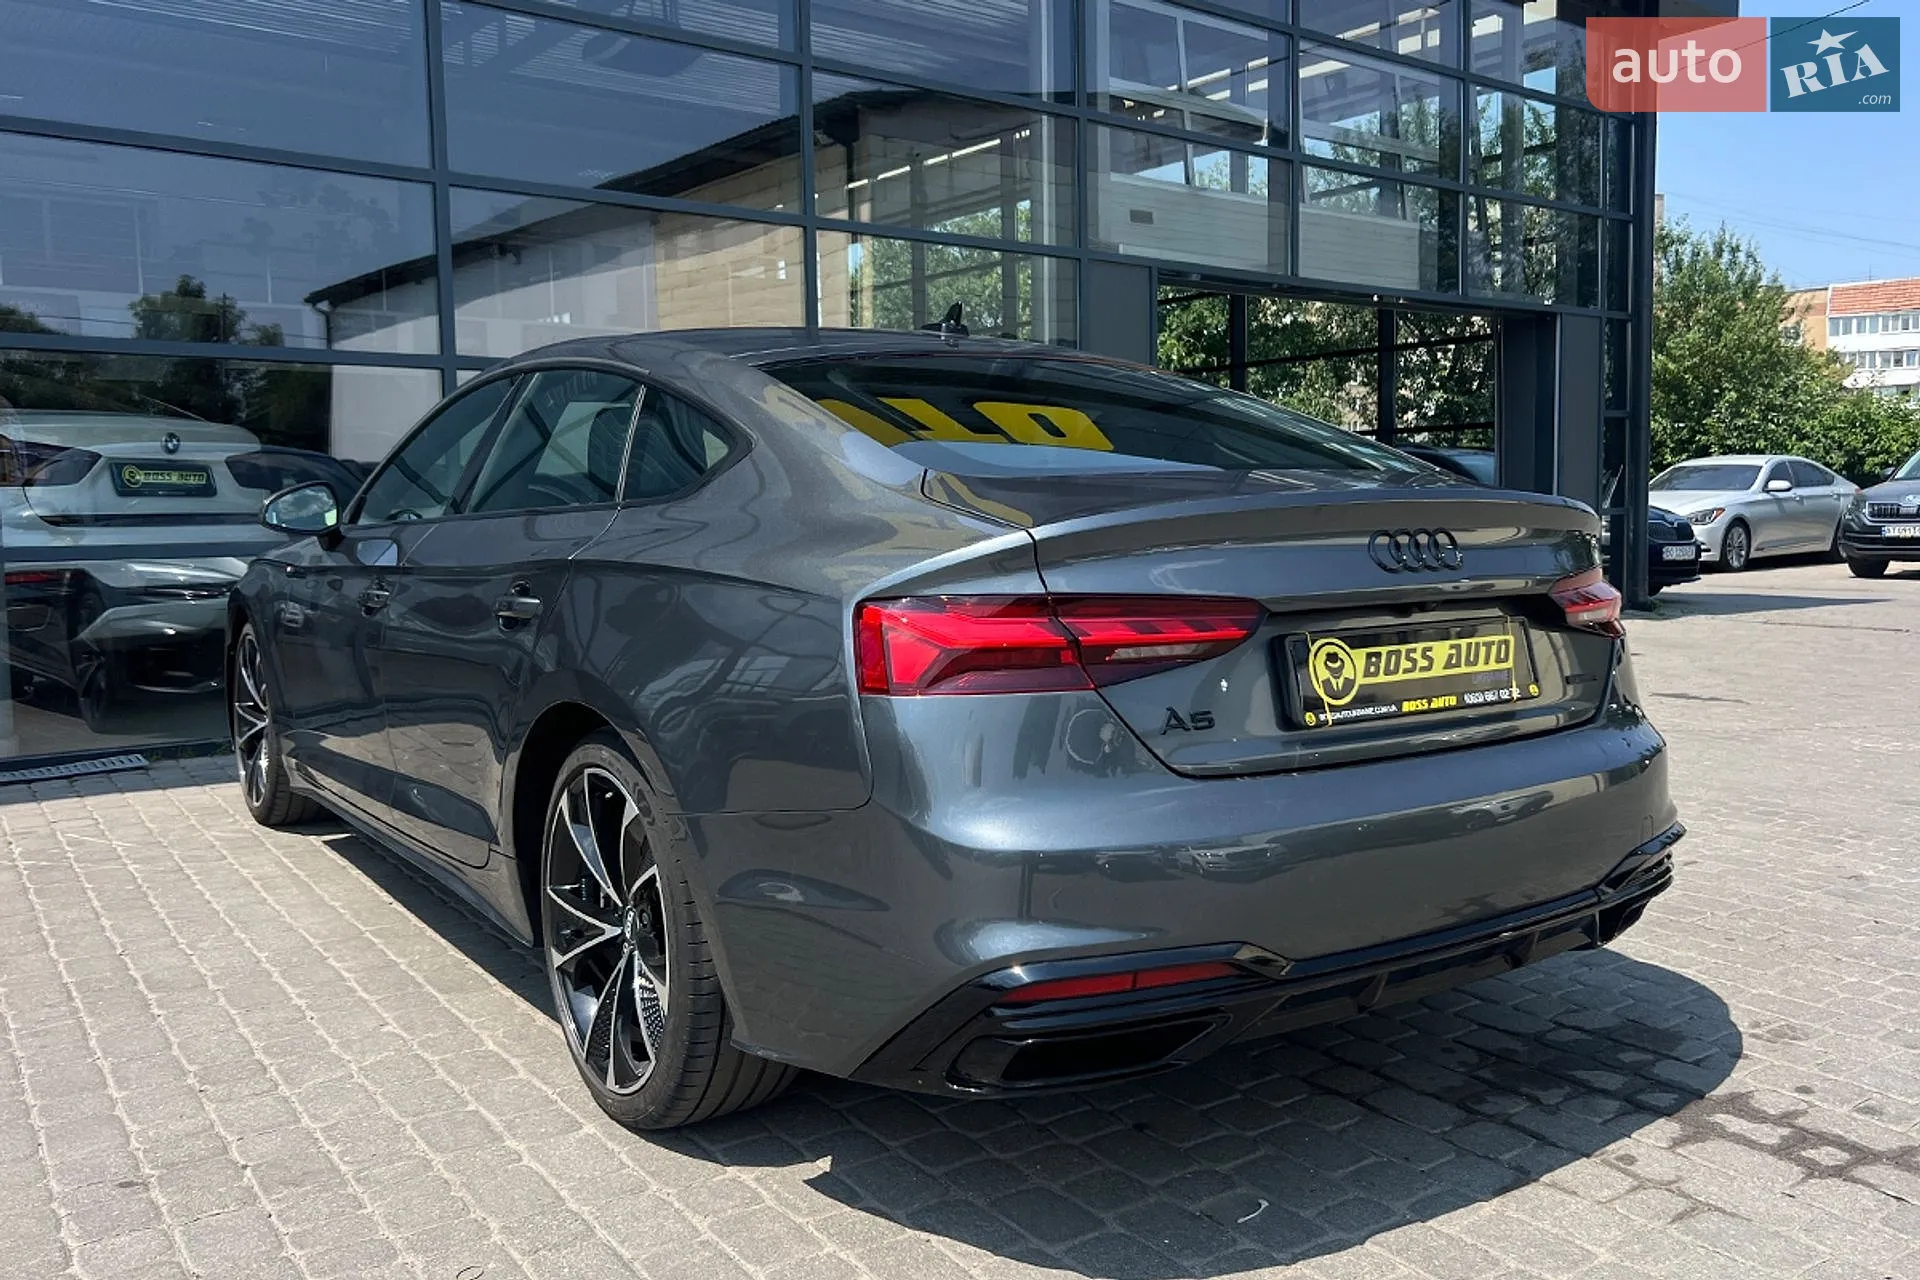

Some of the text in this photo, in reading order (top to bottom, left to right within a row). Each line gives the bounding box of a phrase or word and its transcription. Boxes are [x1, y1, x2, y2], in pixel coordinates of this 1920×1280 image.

[143, 471, 205, 482] BOSS AUTO
[1363, 639, 1511, 678] BOSS AUTO
[1401, 696, 1457, 712] BOSS AUTO
[1160, 706, 1215, 735] A5
